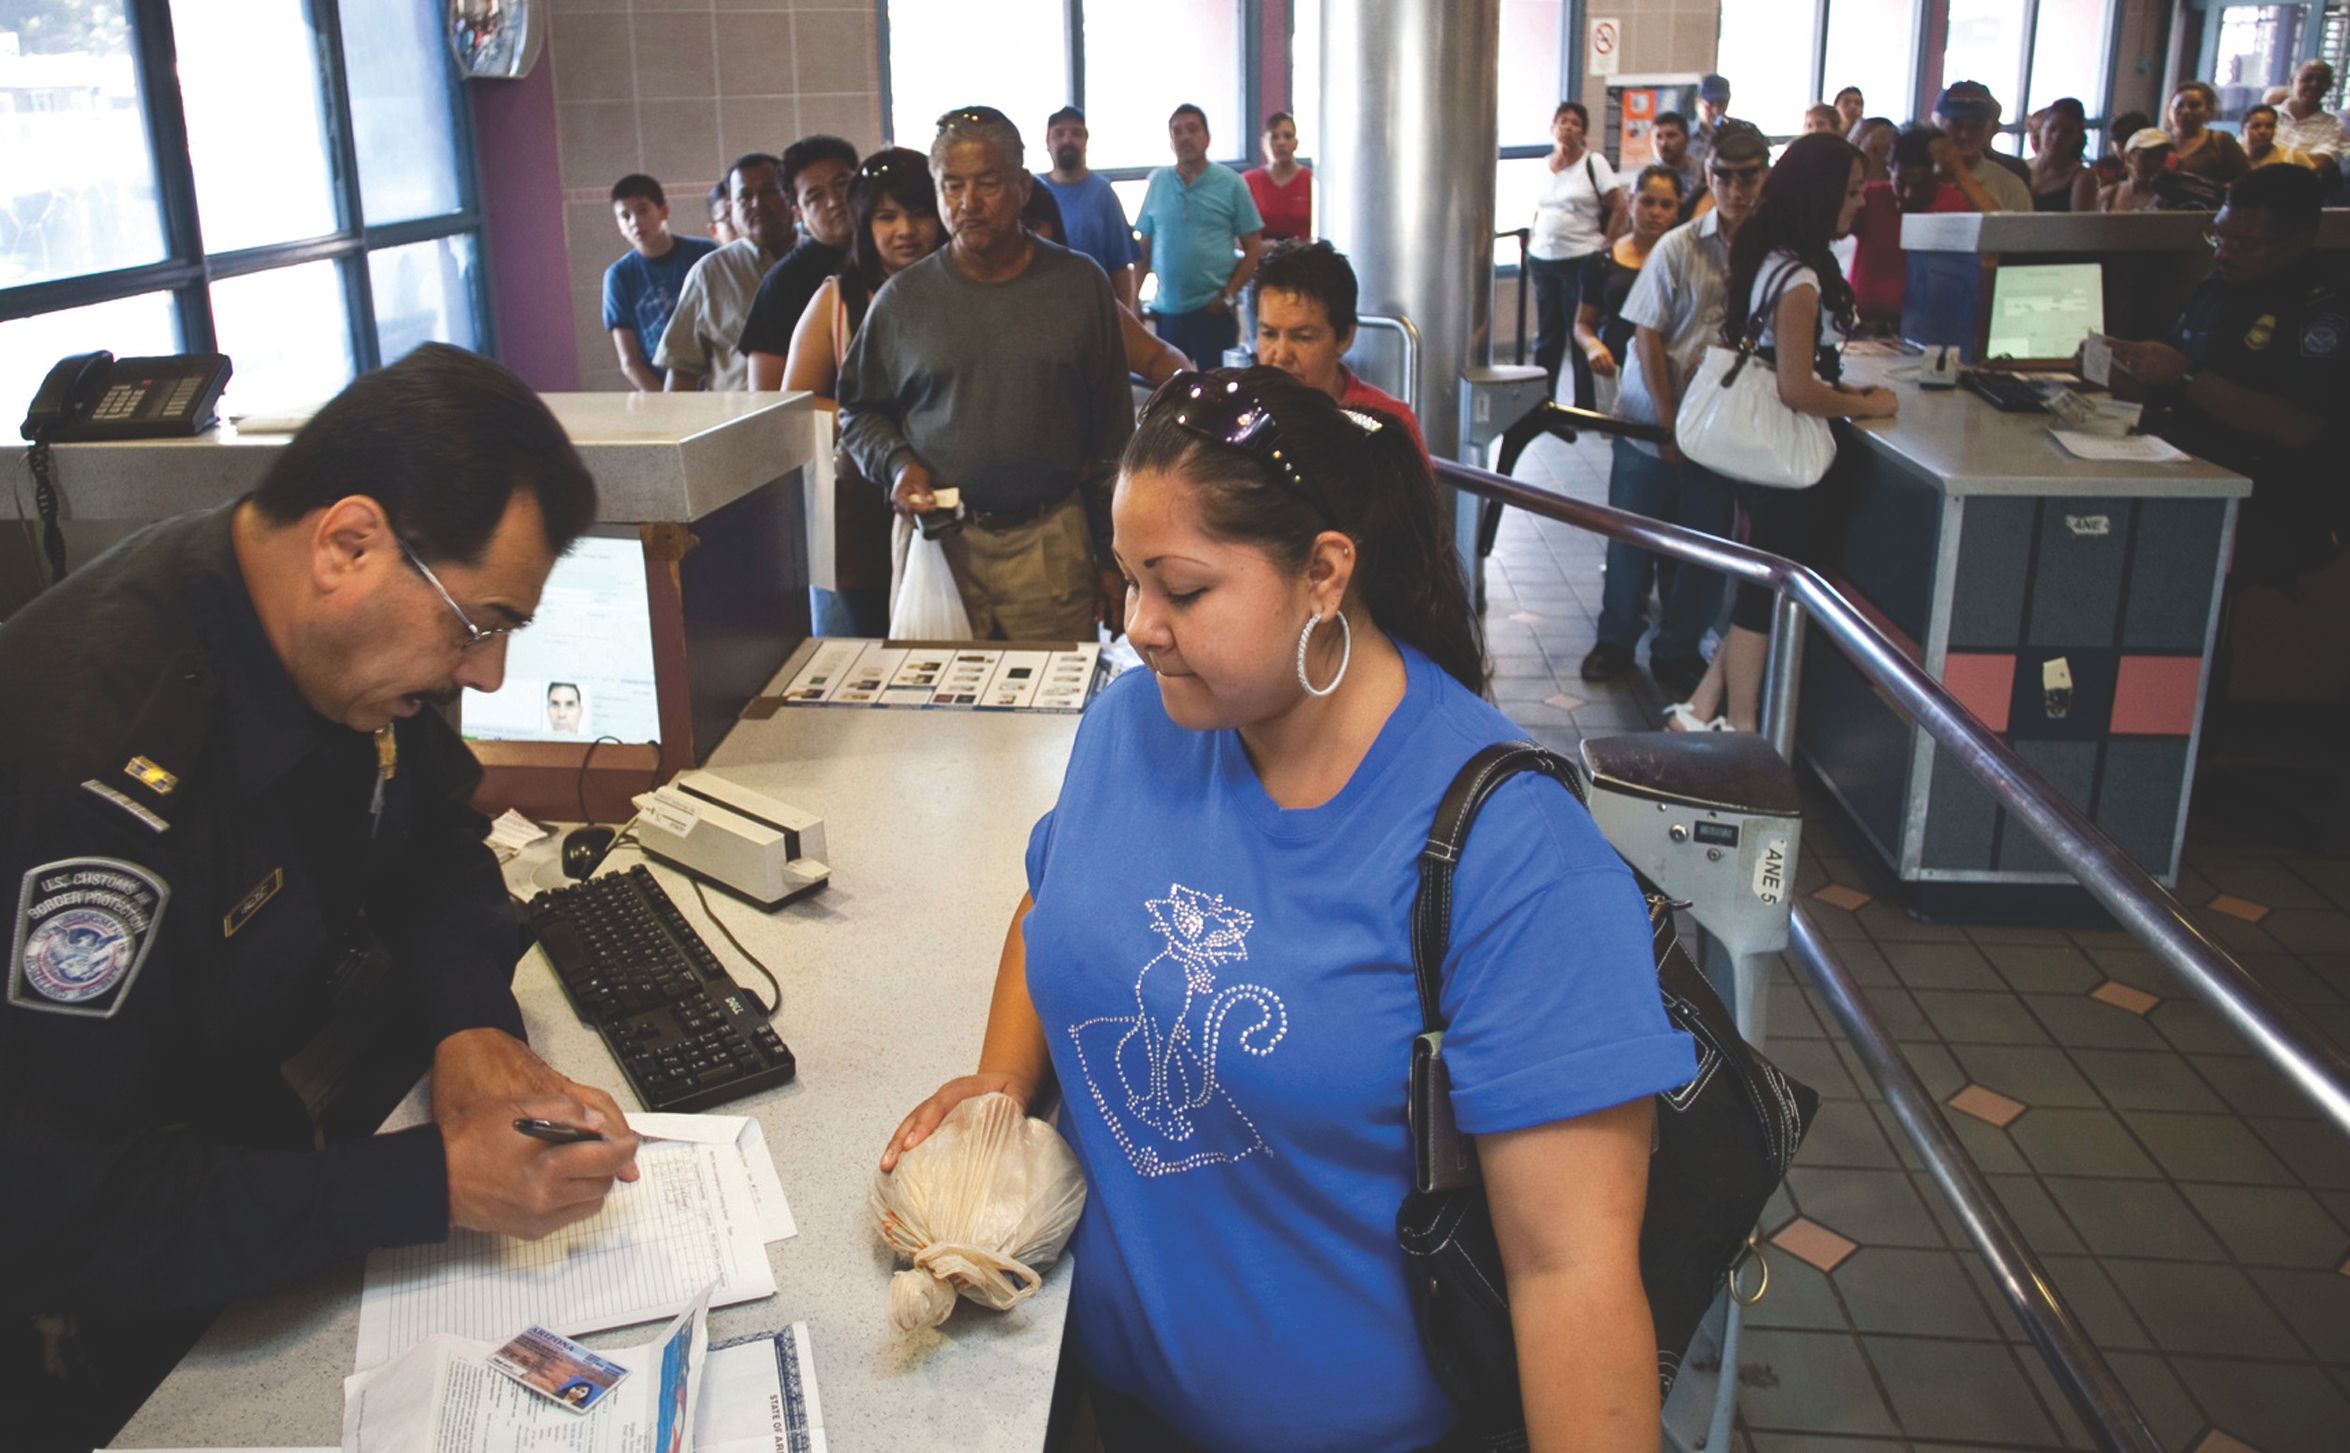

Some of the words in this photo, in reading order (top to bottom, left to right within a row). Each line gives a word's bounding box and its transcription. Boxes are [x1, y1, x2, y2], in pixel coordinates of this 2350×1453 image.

[72, 873, 138, 895] CUSTOMS
[27, 890, 81, 919] BORDER
[1760, 892, 1777, 904] 5
[532, 1326, 575, 1352] ARIZONA
[770, 1394, 780, 1420] STATE
[773, 1422, 782, 1433] OF
